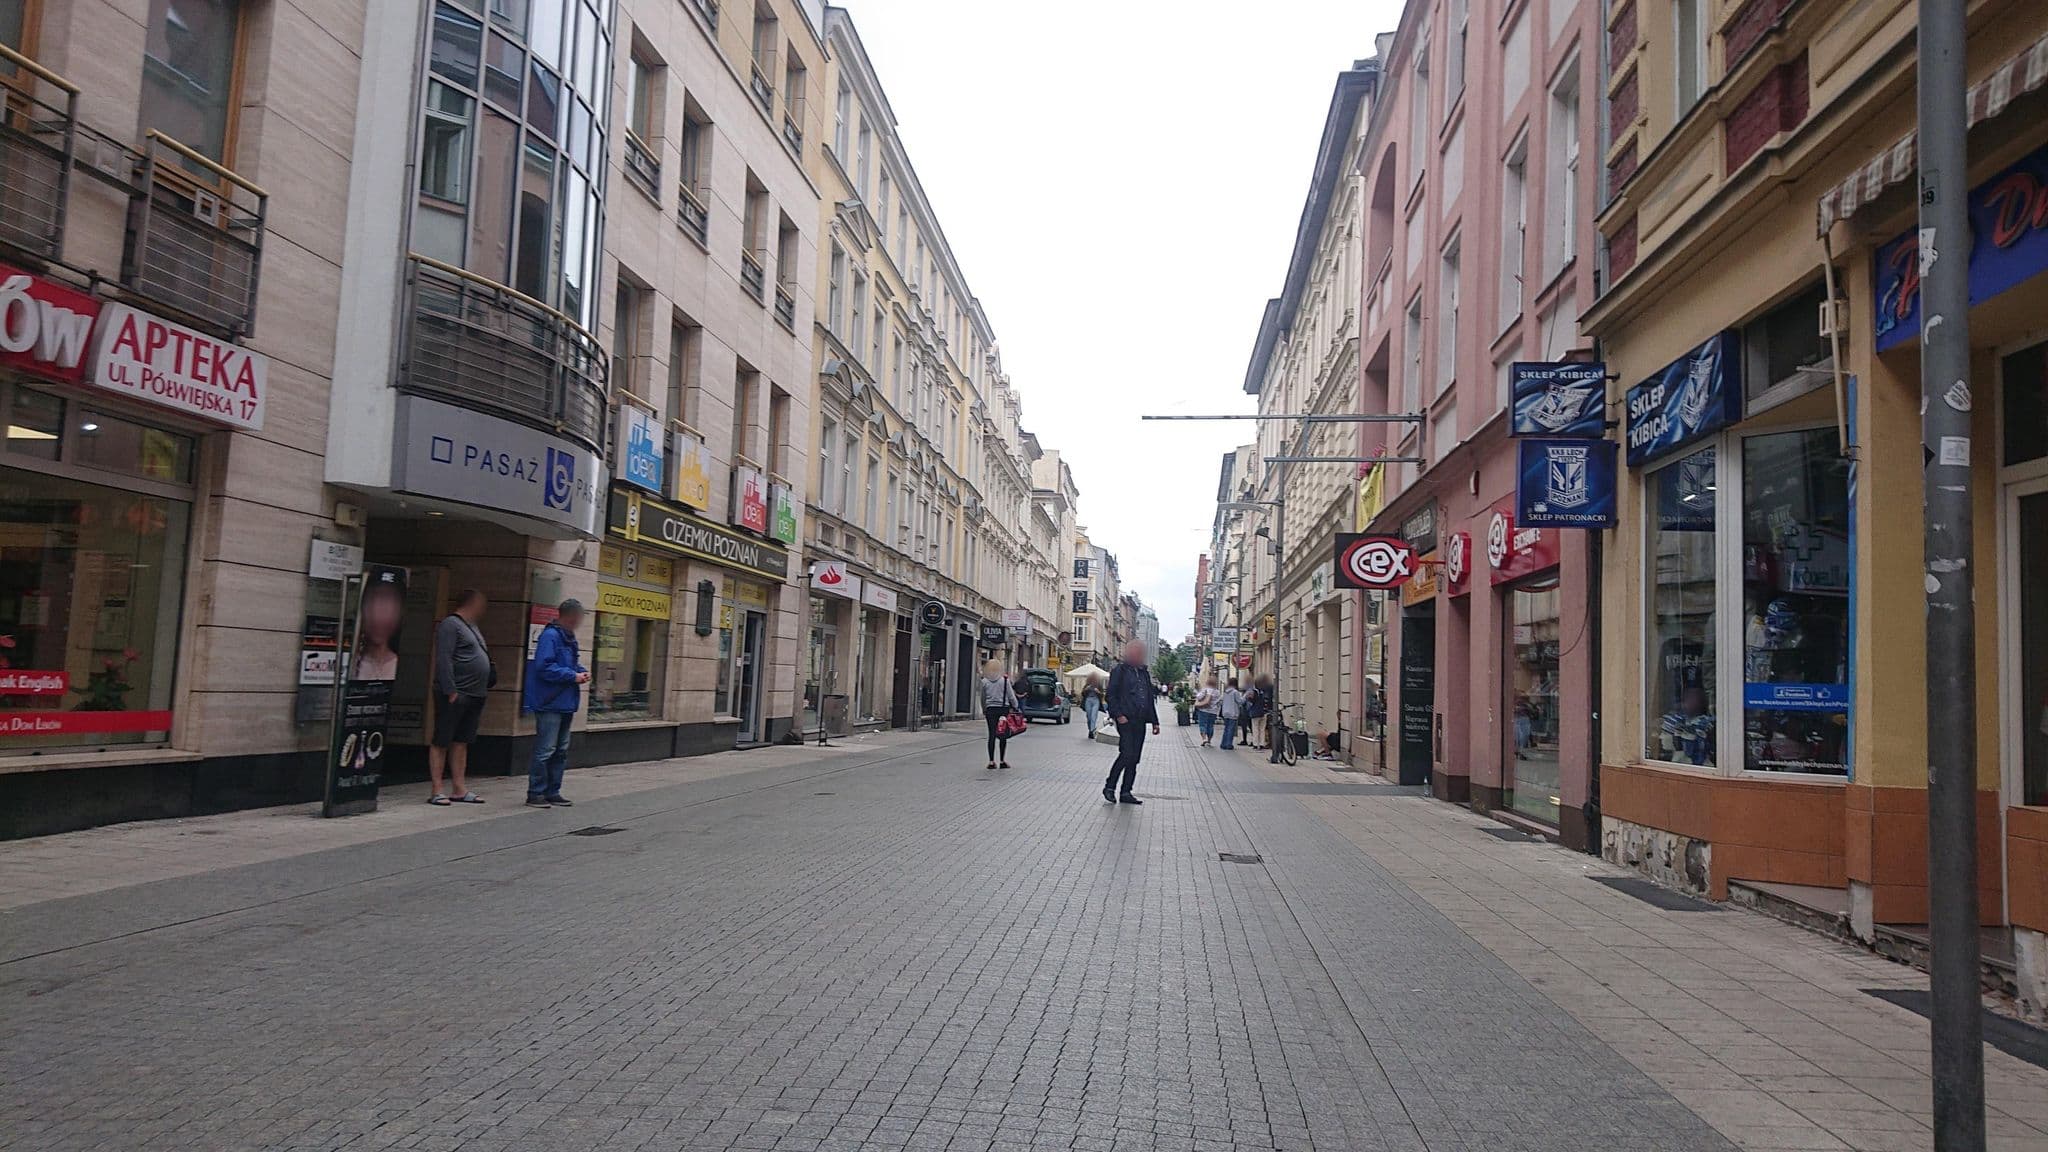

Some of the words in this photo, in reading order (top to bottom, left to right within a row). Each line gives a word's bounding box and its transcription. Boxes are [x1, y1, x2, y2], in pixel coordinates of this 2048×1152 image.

[111, 312, 258, 399] APTEKA
[108, 362, 134, 387] UL.
[140, 367, 233, 417] PÓŁWIEJSKA
[239, 400, 257, 421] 17
[1519, 371, 1555, 379] SKLEP
[1559, 371, 1600, 379] KIBICA
[1631, 383, 1665, 419] SKLEP
[1631, 414, 1669, 448] KIBICA
[464, 445, 539, 483] PASAŻ
[1555, 514, 1606, 522] PATRONACKI
[662, 518, 713, 552] CIŻEMKI
[714, 538, 759, 567] POZNAŃ
[18, 675, 63, 692] English
